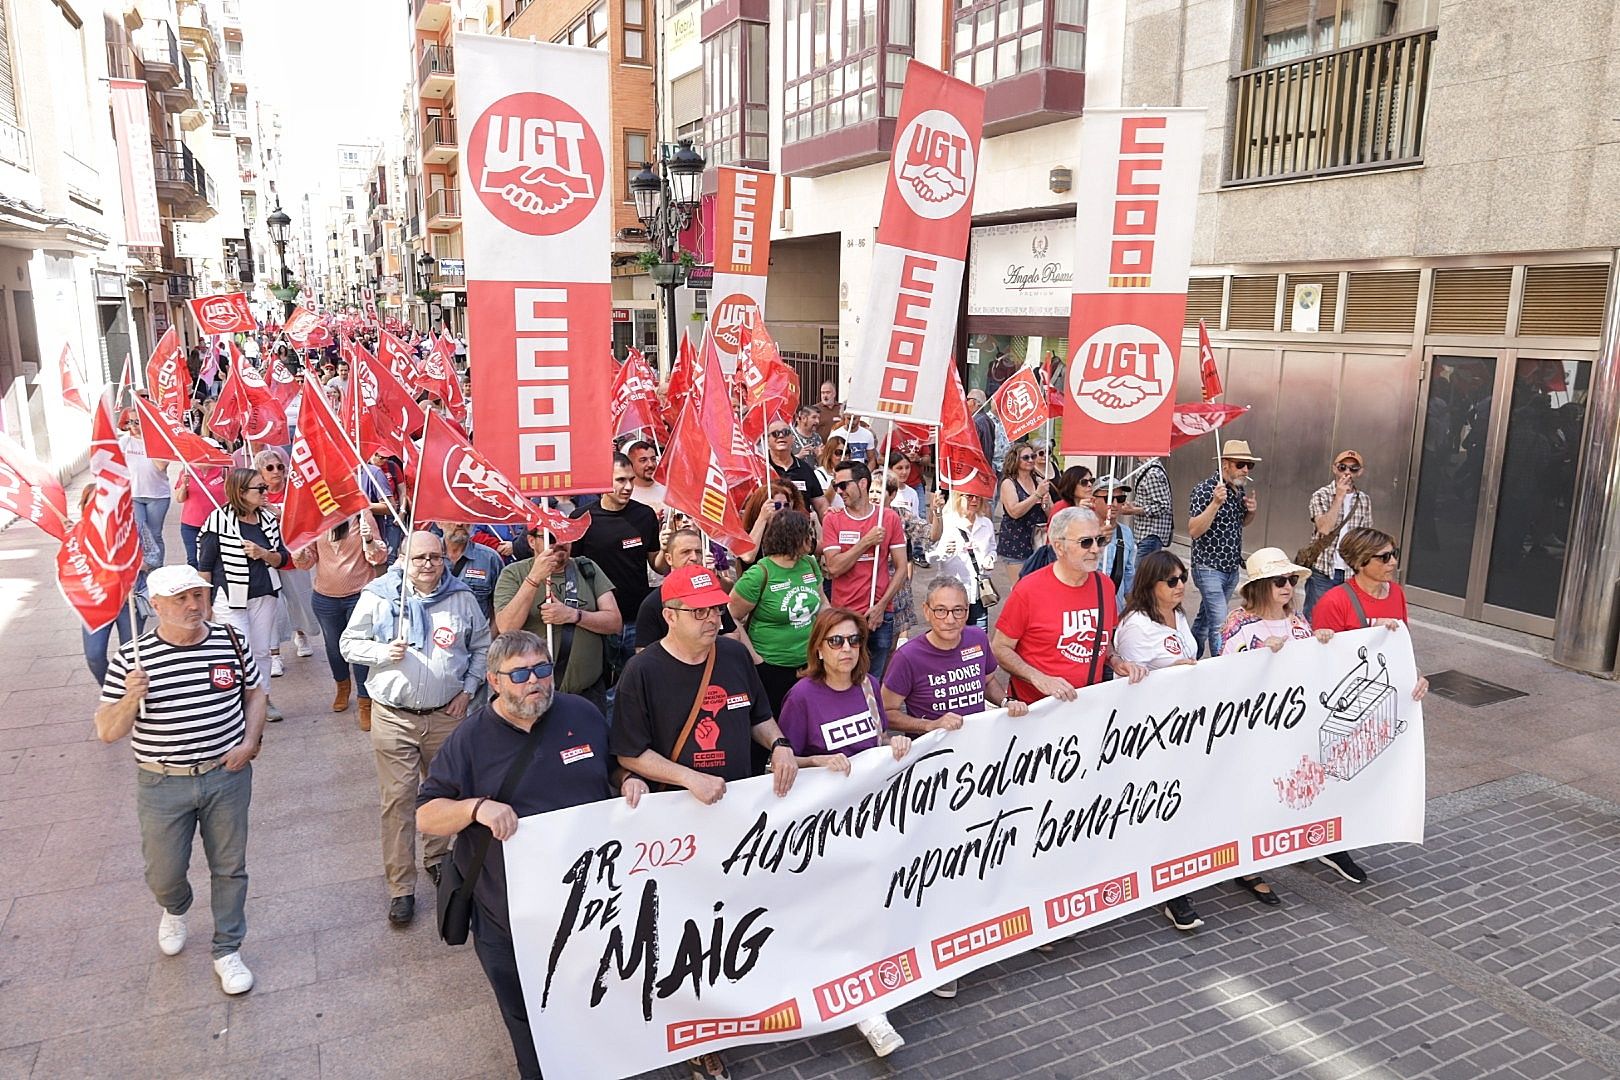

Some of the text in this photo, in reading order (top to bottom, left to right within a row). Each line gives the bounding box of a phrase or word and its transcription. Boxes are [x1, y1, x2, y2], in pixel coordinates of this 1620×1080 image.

[484, 115, 585, 177] UGT
[907, 123, 967, 178] UGT
[1109, 117, 1167, 274] CCOO
[731, 172, 758, 264] CCOO
[1003, 264, 1040, 291] Angelo
[205, 302, 235, 317] UGT
[719, 304, 758, 330] UGT
[879, 254, 938, 403] CCOO
[1082, 342, 1161, 380] UGT
[514, 287, 573, 475] CCOO
[1062, 608, 1100, 634] UGT
[928, 664, 981, 687] Les DONES
[934, 680, 982, 698] es mouen
[932, 690, 984, 711] en CCOO
[828, 715, 878, 745] CCOO
[693, 760, 726, 768] industria
[721, 685, 1307, 874] Augmentar salaris, baixar preus
[628, 834, 697, 876] 2023
[884, 780, 1182, 909] repartir beneficis
[1258, 828, 1304, 858] UGT
[1155, 855, 1212, 886] CCOO
[578, 891, 623, 933] DE
[1053, 888, 1100, 923] UGT
[936, 925, 1002, 963] CCOO
[822, 969, 878, 1014] UGT
[674, 1019, 760, 1045] CCOO
